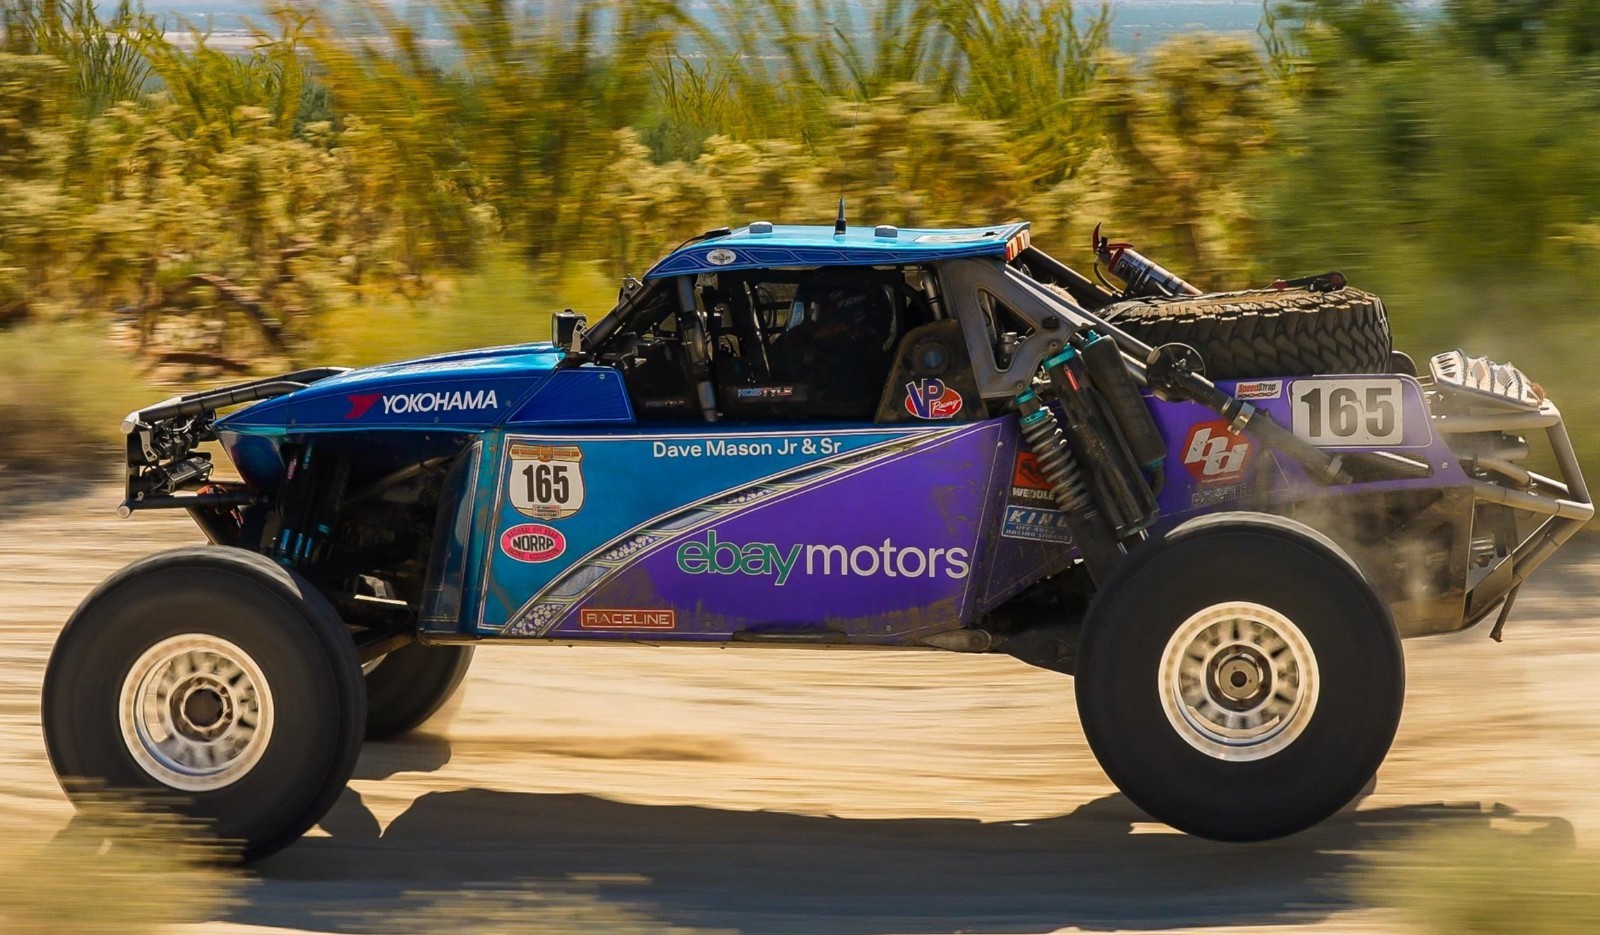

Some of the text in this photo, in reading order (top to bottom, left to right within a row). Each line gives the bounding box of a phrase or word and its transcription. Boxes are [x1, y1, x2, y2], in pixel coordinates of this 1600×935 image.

[382, 390, 498, 415] YOKOHAMA
[906, 378, 946, 419] VP
[931, 400, 959, 414] Racing
[1300, 387, 1395, 437] 165
[653, 438, 842, 458] Dave Mason Jr & Sr
[522, 464, 570, 504] 165
[512, 534, 555, 552] NORRA
[676, 529, 971, 586] ebay motors
[585, 613, 671, 626] RACELINE
